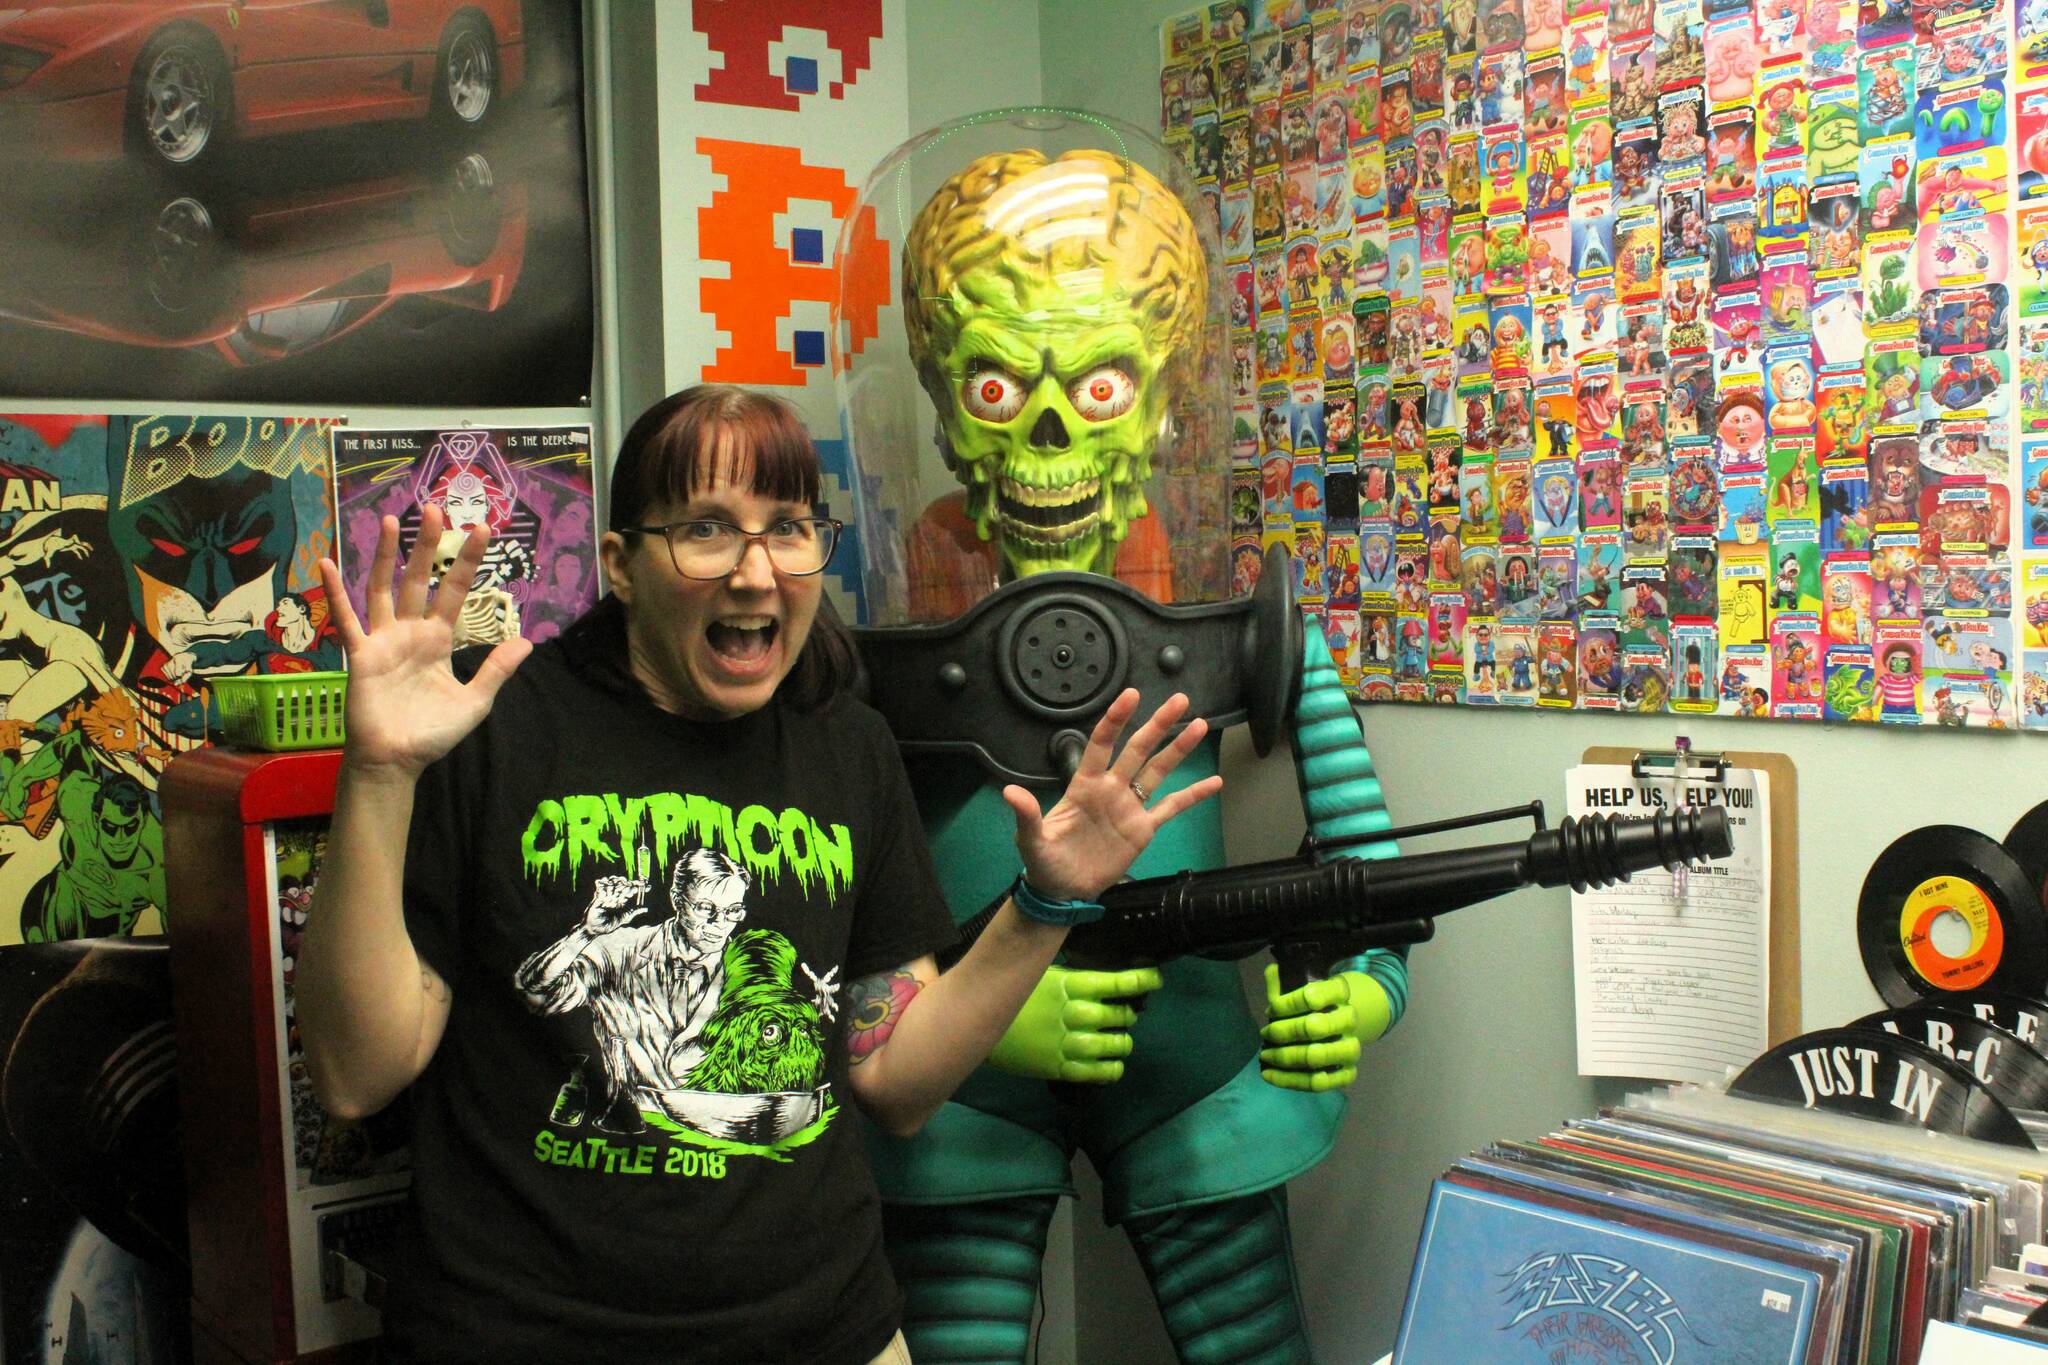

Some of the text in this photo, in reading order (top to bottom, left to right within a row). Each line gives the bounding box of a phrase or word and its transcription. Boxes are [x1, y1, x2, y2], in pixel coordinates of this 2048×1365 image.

[344, 439, 359, 451] THE
[363, 439, 387, 450] FIRST
[507, 433, 576, 447] IS THE DEEPES
[1585, 787, 1753, 811] HELP US, ELP YOU!
[521, 792, 853, 908] CRYPTICON
[1690, 866, 1729, 876] ALBUM TITLE
[1788, 1046, 1943, 1124] JUST IN
[533, 1130, 727, 1179] SEATTLE 2018
